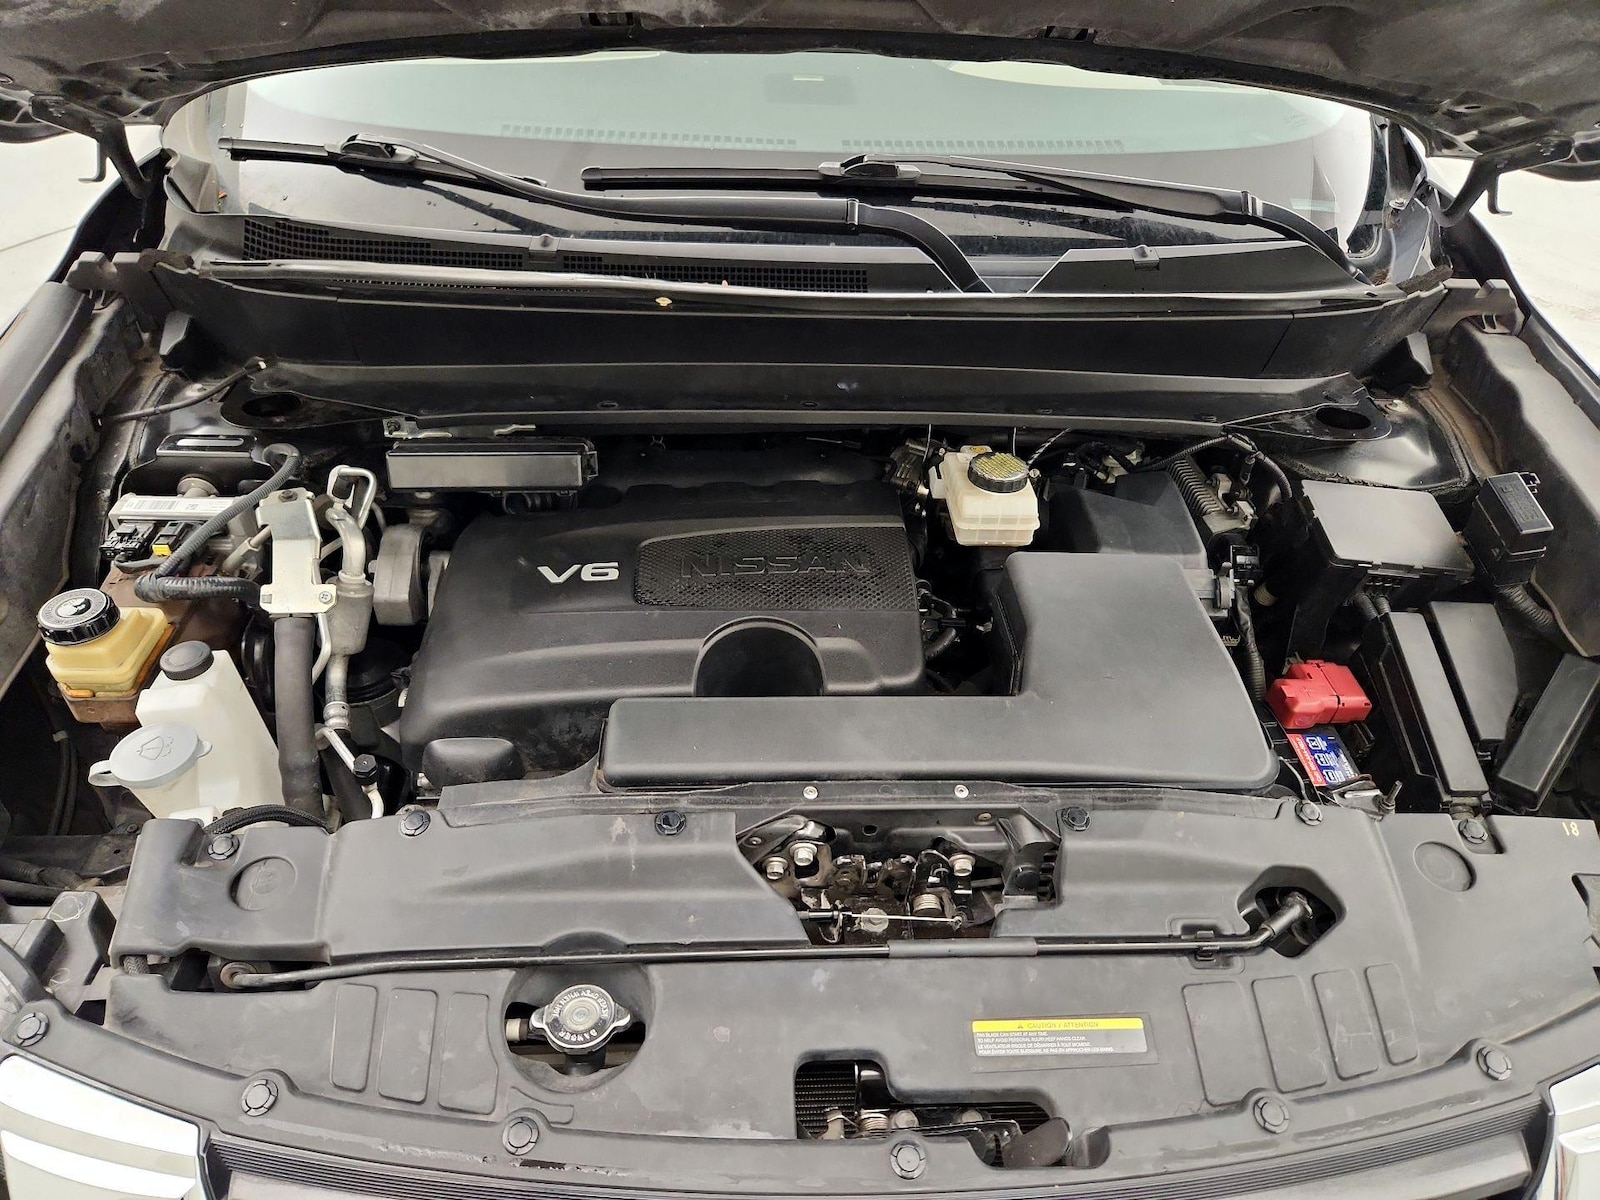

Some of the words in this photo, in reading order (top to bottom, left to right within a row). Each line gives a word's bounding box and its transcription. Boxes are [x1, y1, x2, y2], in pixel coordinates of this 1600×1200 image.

[537, 562, 620, 584] V6
[680, 552, 871, 578] NISSAN
[1562, 821, 1580, 837] 18
[558, 1028, 598, 1041] DANGER
